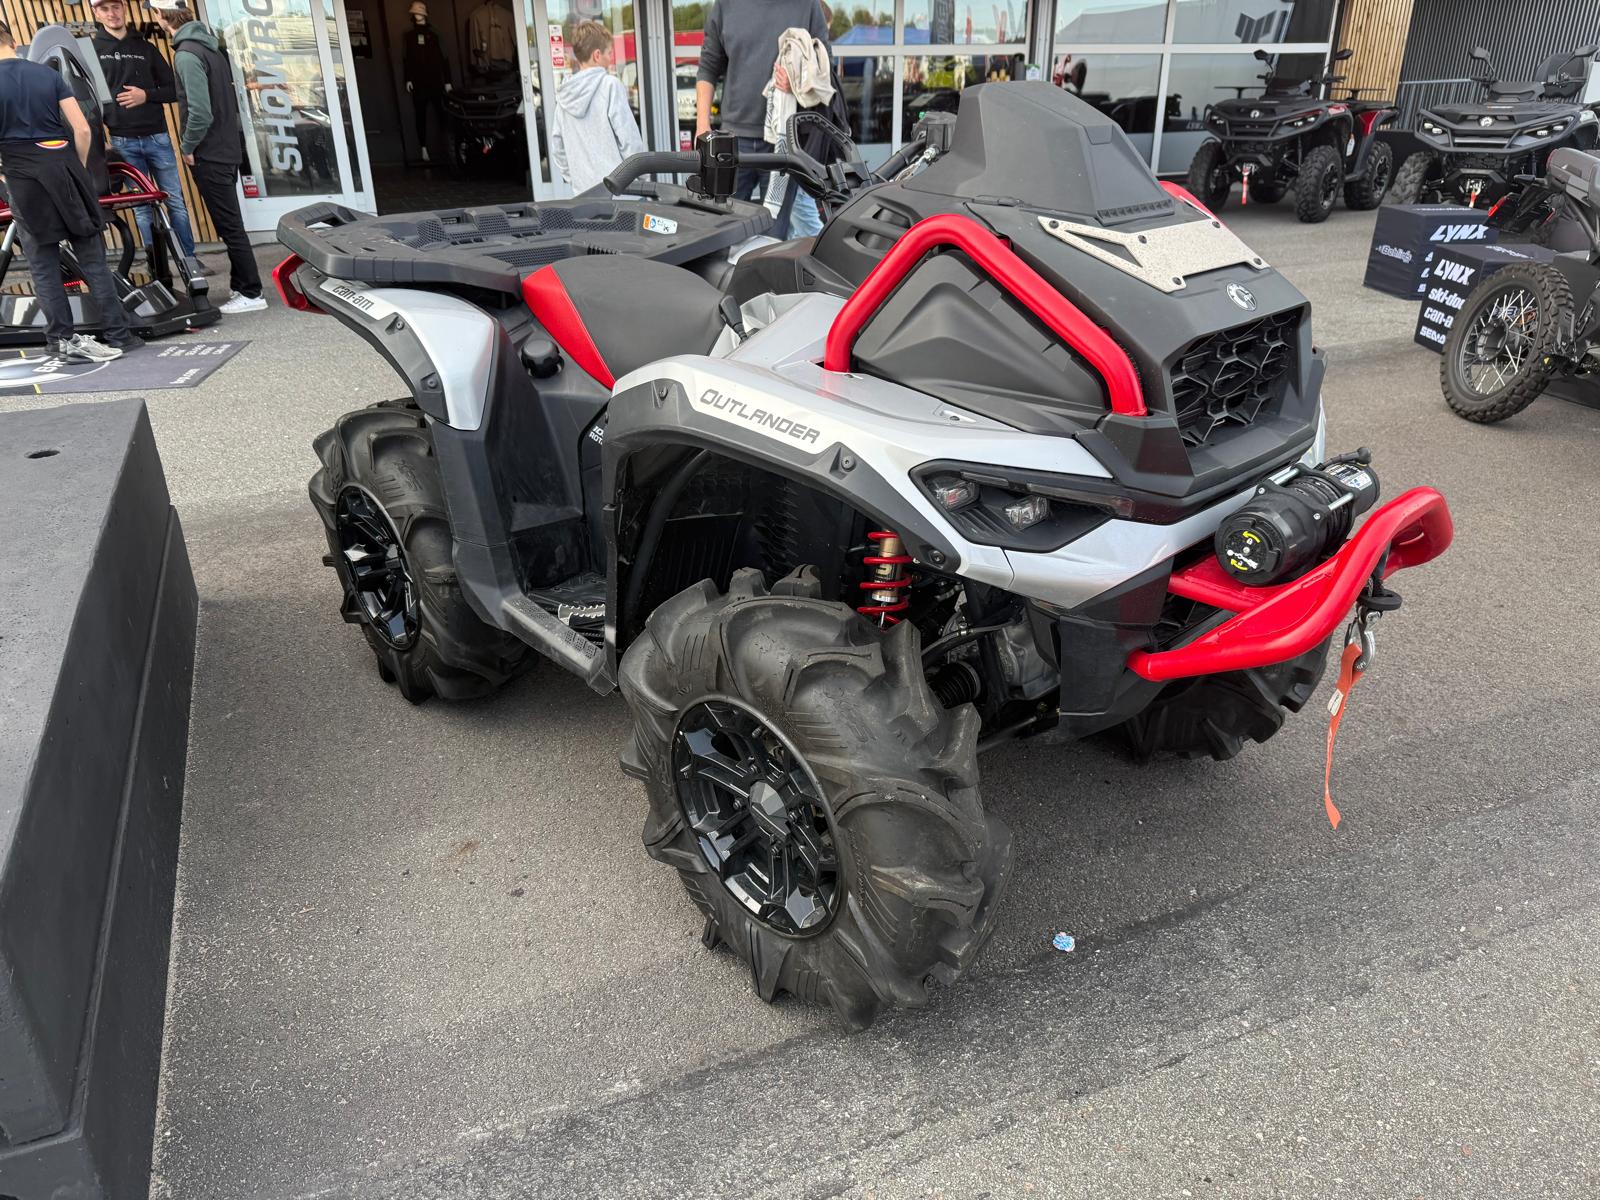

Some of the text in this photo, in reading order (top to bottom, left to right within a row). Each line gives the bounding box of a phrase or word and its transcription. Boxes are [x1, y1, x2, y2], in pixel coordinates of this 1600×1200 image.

[1430, 224, 1489, 243] LYNX
[1433, 258, 1476, 286] LYNX
[332, 285, 375, 311] can-am
[700, 388, 821, 444] OUTLANDER
